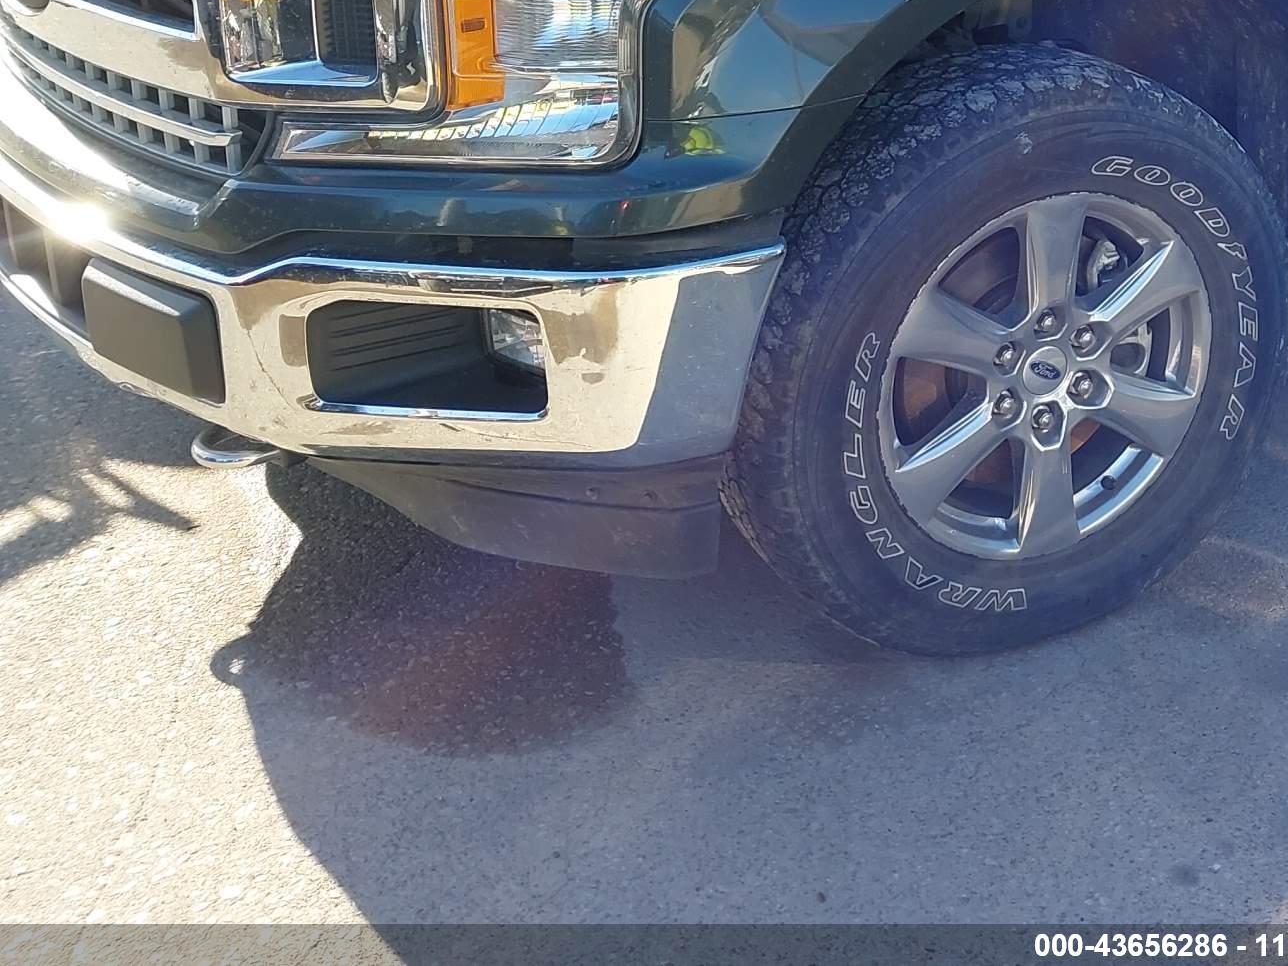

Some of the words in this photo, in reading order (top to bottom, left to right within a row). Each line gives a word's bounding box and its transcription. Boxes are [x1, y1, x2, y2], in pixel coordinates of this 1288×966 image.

[1032, 362, 1058, 379] Ford
[1090, 155, 1260, 442] GOODYEAR
[842, 330, 1029, 613] WRANGLER
